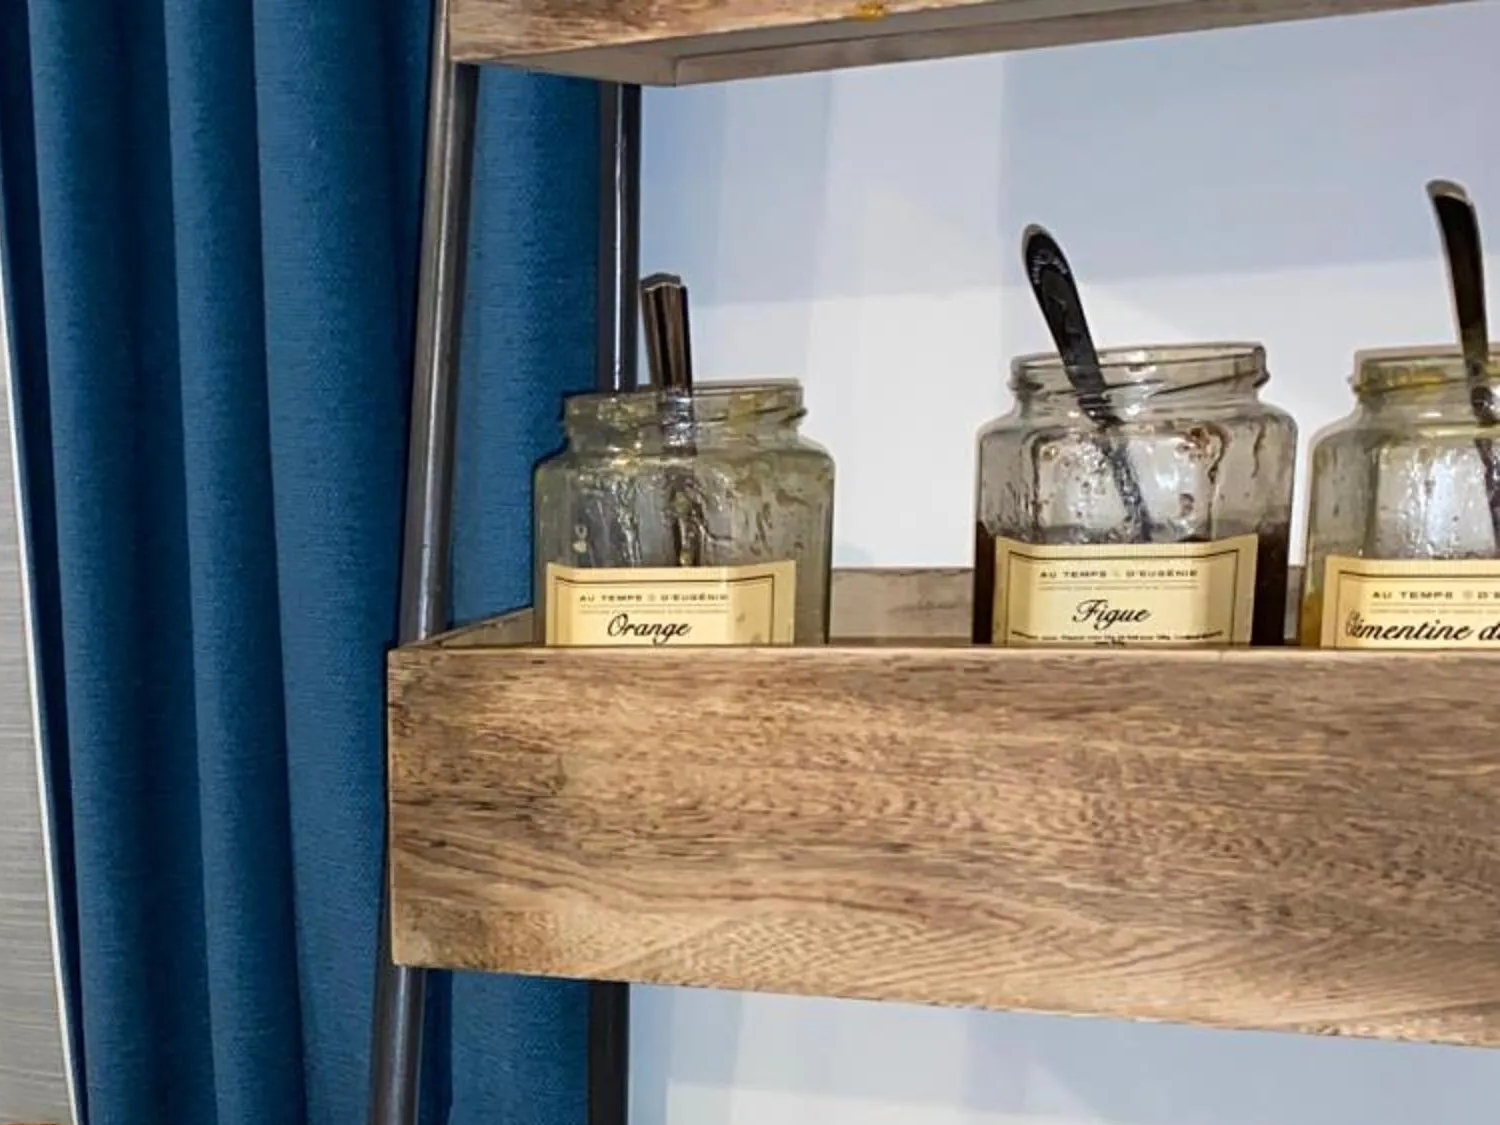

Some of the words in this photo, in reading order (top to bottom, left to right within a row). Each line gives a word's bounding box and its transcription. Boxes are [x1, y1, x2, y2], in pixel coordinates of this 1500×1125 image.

[1063, 570, 1107, 578] TEMPS
[1400, 591, 1453, 600] TEMPS
[1071, 598, 1151, 631] Figue
[607, 612, 692, 646] Orange
